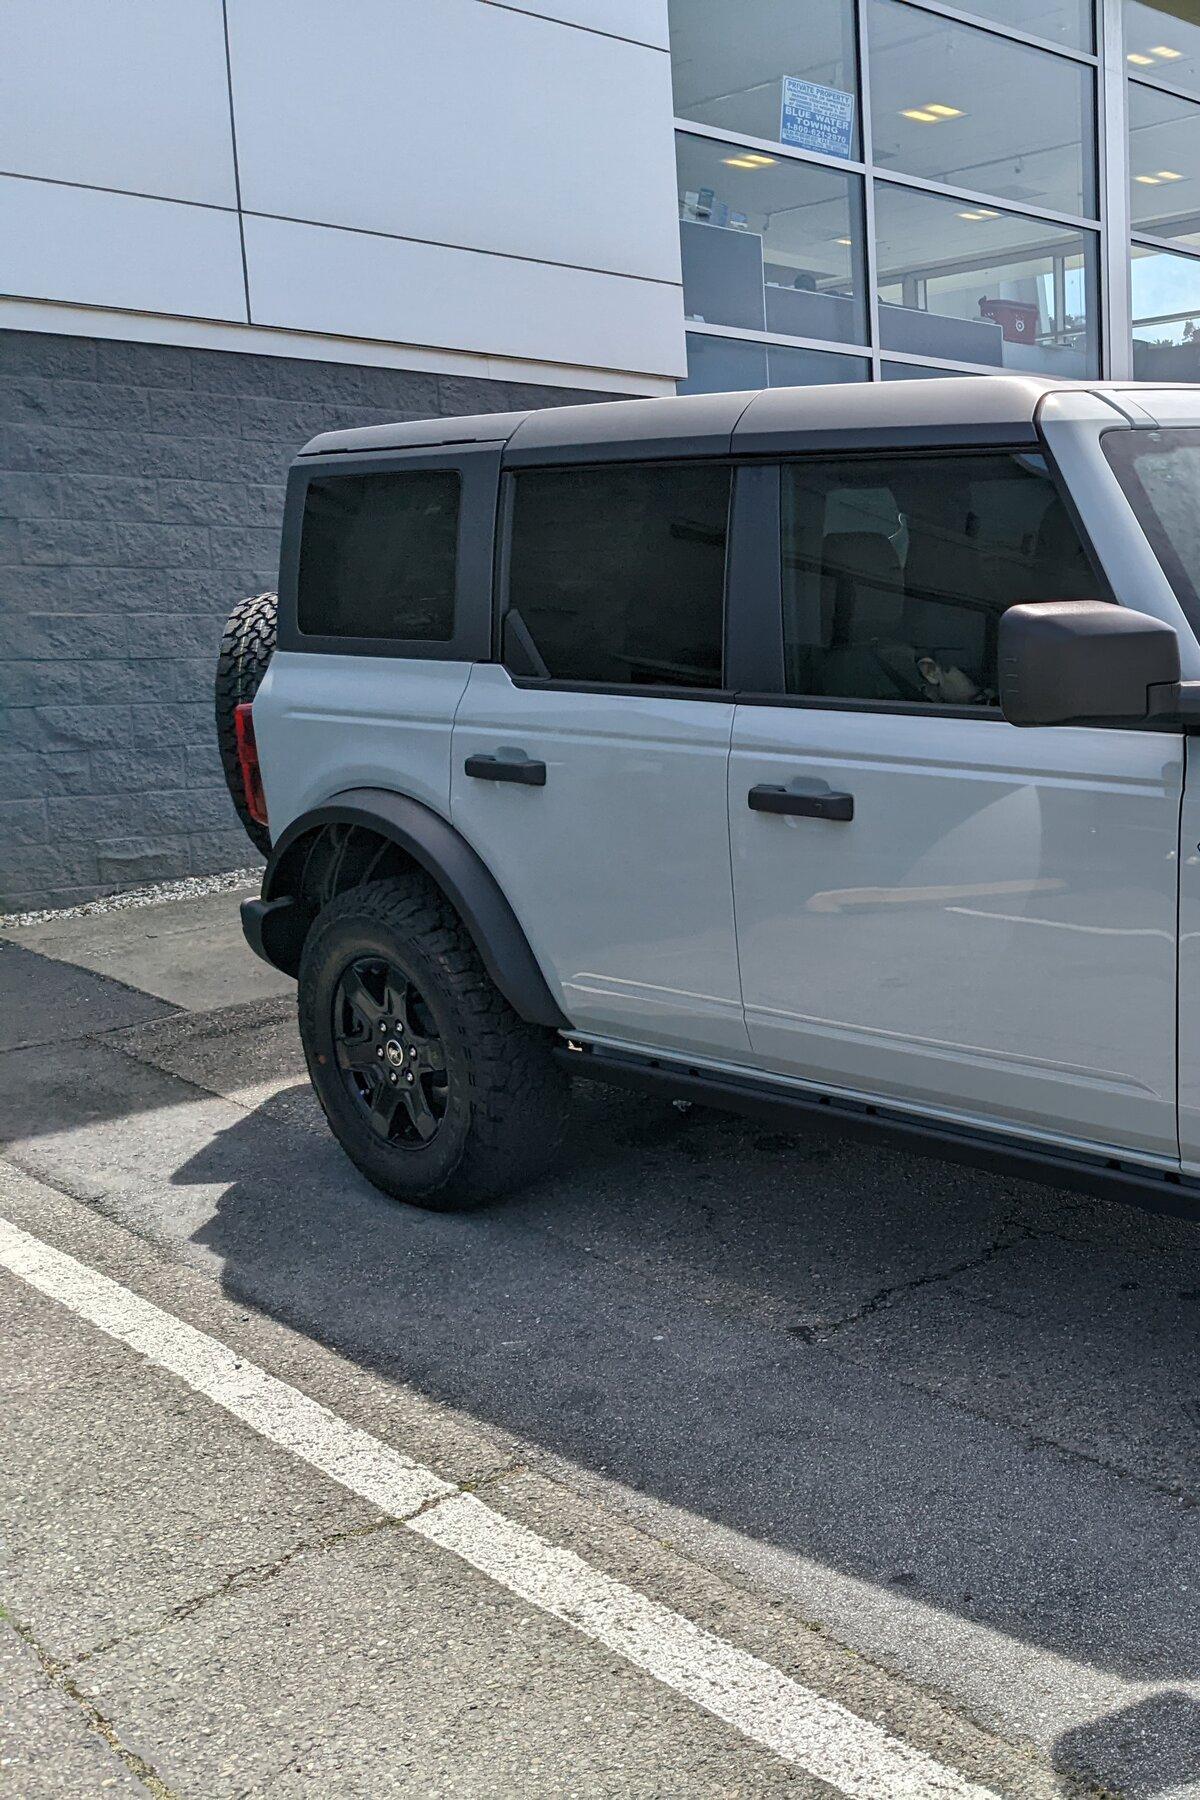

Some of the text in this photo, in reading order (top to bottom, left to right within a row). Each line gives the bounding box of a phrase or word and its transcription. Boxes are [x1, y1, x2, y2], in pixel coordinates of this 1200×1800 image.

[787, 80, 849, 103] PRIVATE PROPERTY
[785, 107, 811, 119] BLUE
[816, 114, 849, 130] WATER
[796, 117, 838, 134] TOWING
